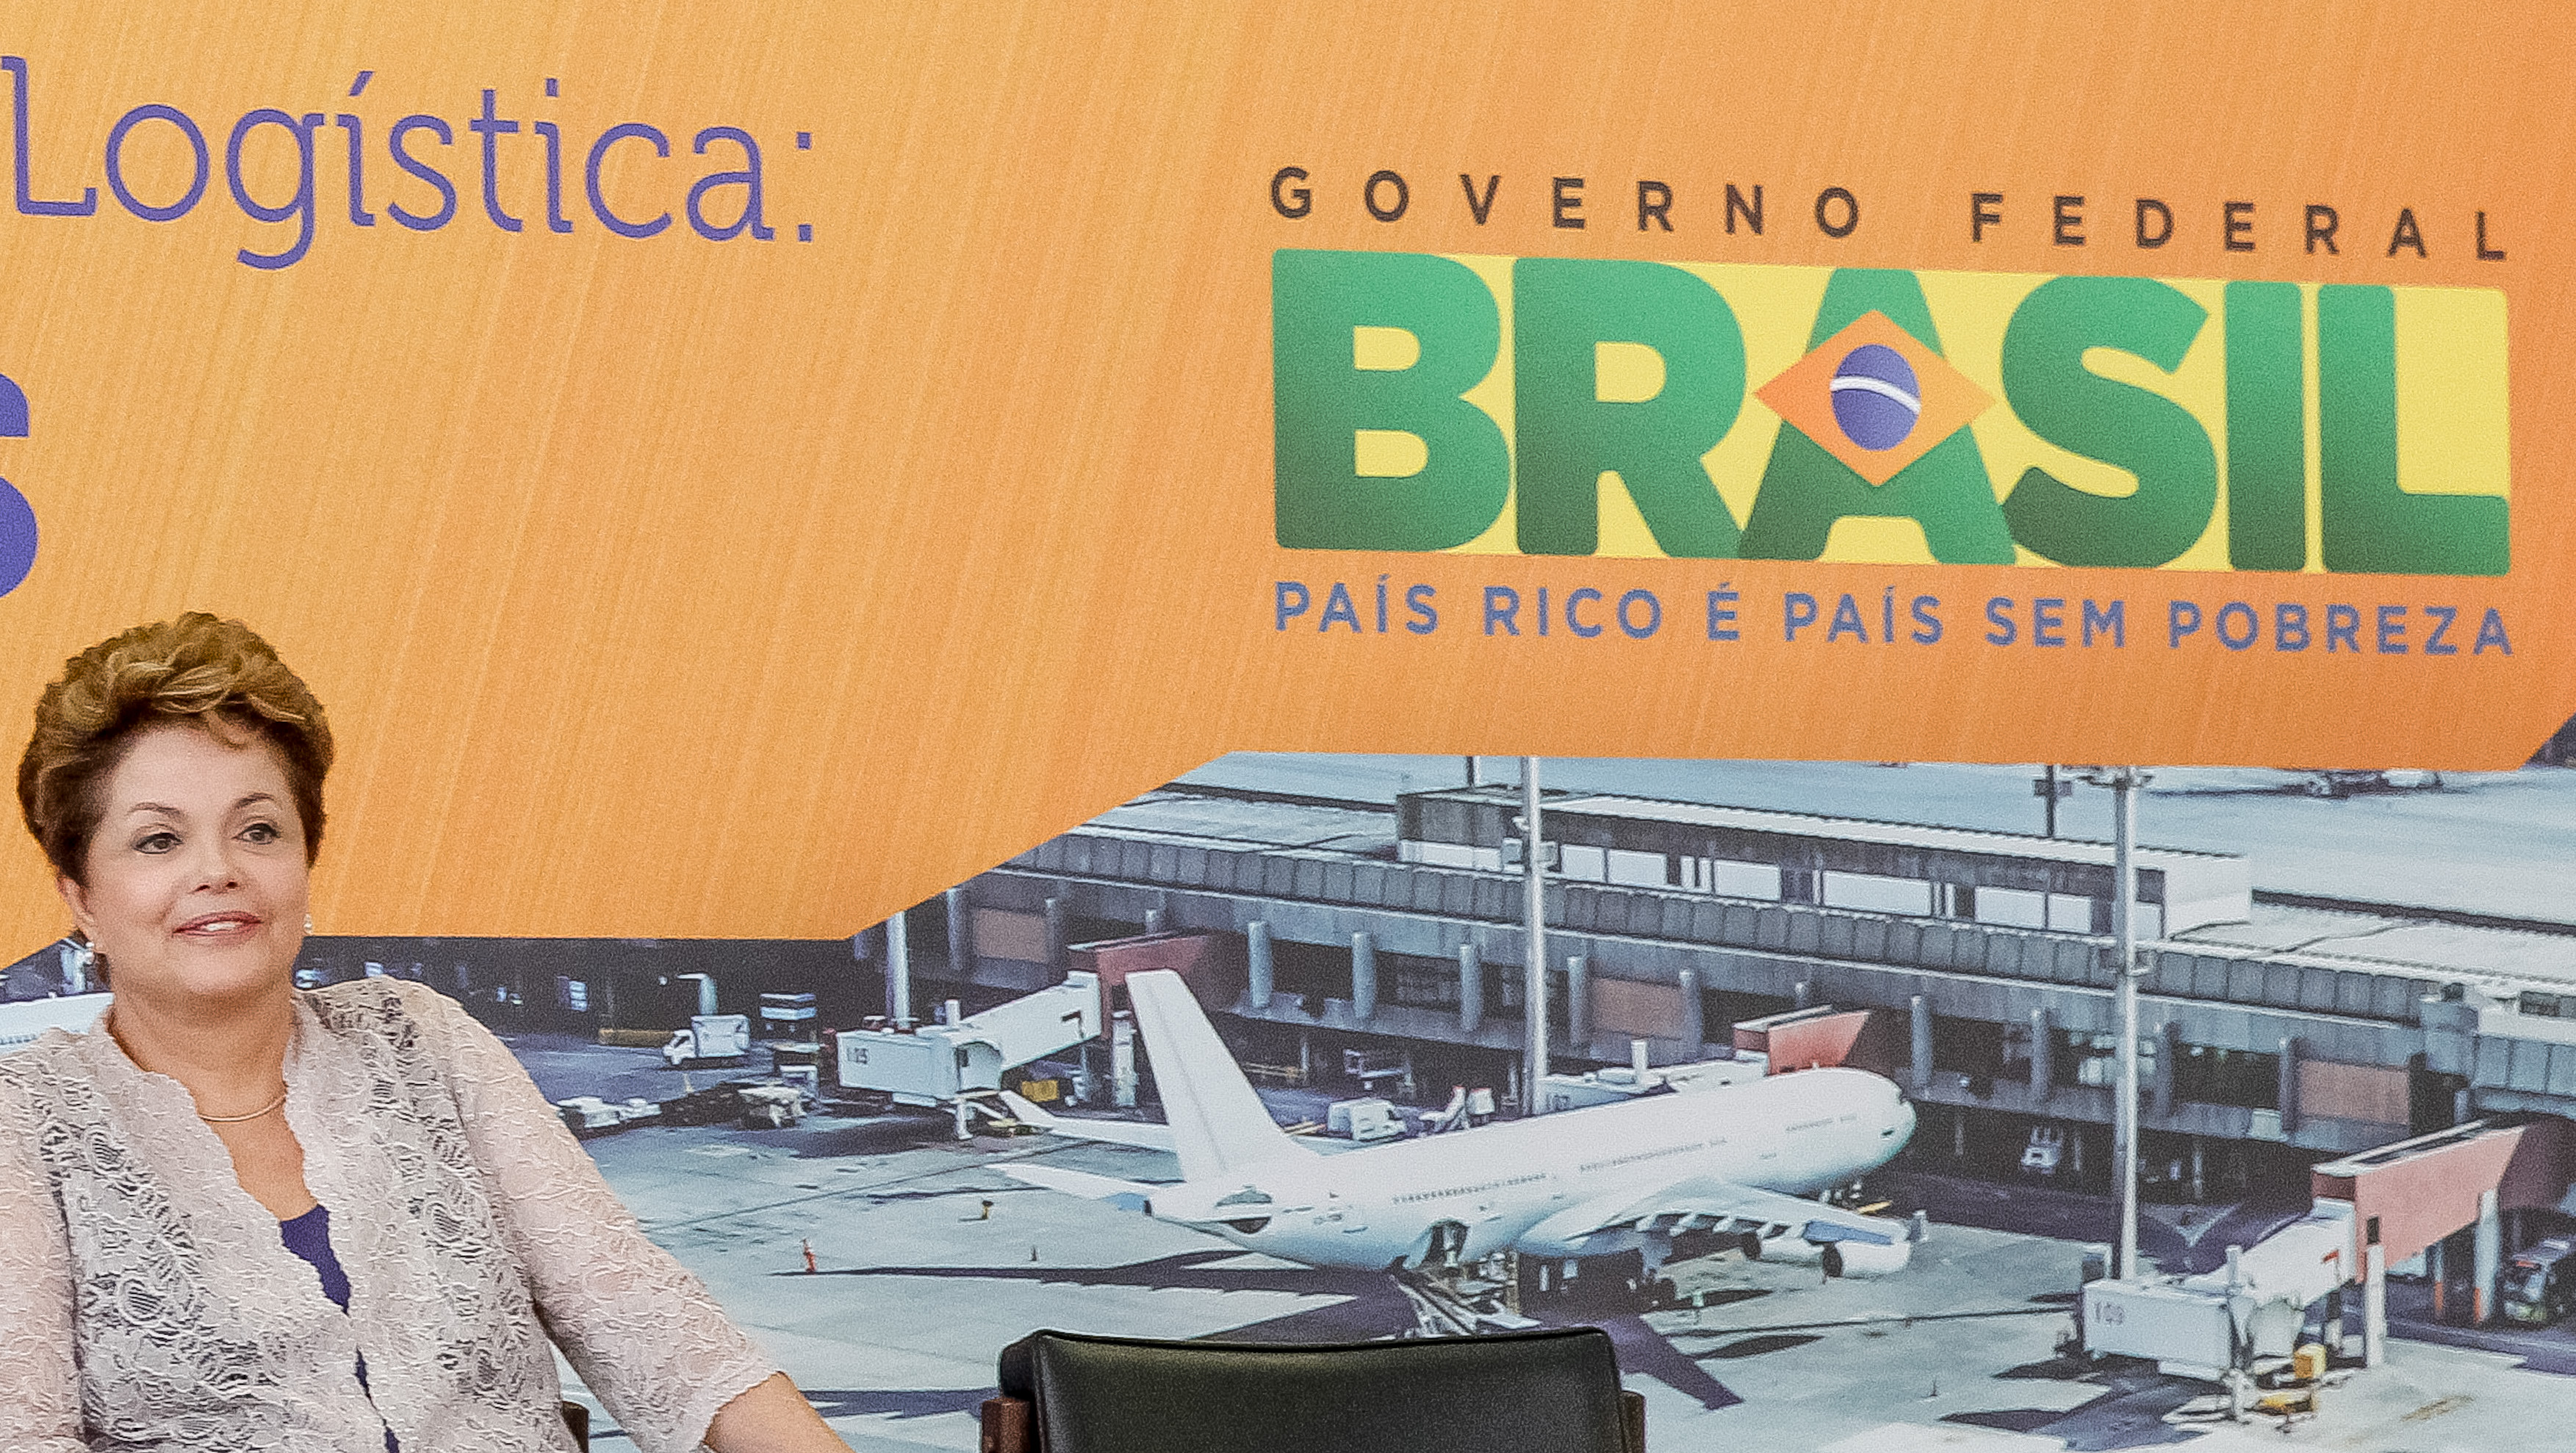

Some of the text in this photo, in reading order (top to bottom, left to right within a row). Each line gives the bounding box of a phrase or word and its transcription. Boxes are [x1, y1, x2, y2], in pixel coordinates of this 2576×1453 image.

[0, 55, 814, 270] Logística:
[1272, 166, 2506, 261] GOVERNO FEDERAL
[1273, 250, 2510, 576] BRASIL
[1274, 574, 2514, 657] PAÍS RICO É PAÍS SEM POBREZA
